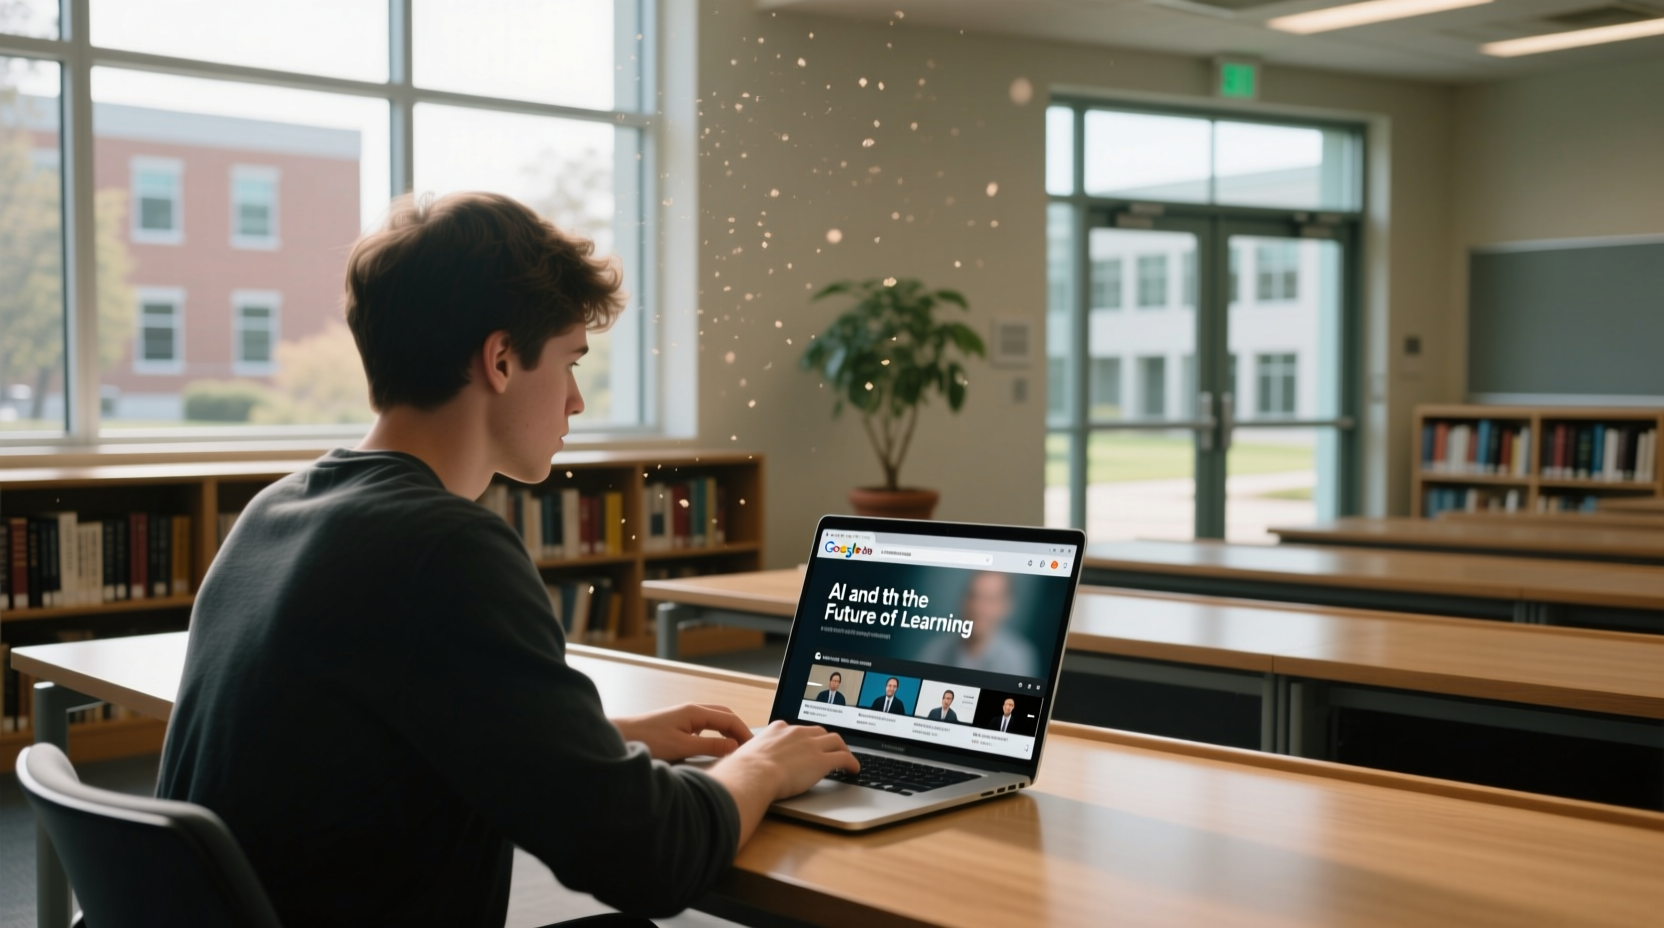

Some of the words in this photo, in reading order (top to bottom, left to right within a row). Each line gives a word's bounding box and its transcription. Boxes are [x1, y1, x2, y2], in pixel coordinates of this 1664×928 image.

[828, 582, 847, 601] AI
[848, 586, 880, 604] and
[882, 587, 899, 607] th
[902, 589, 929, 608] the
[824, 603, 877, 625] Future
[880, 609, 898, 627] of
[900, 610, 974, 639] Learning
